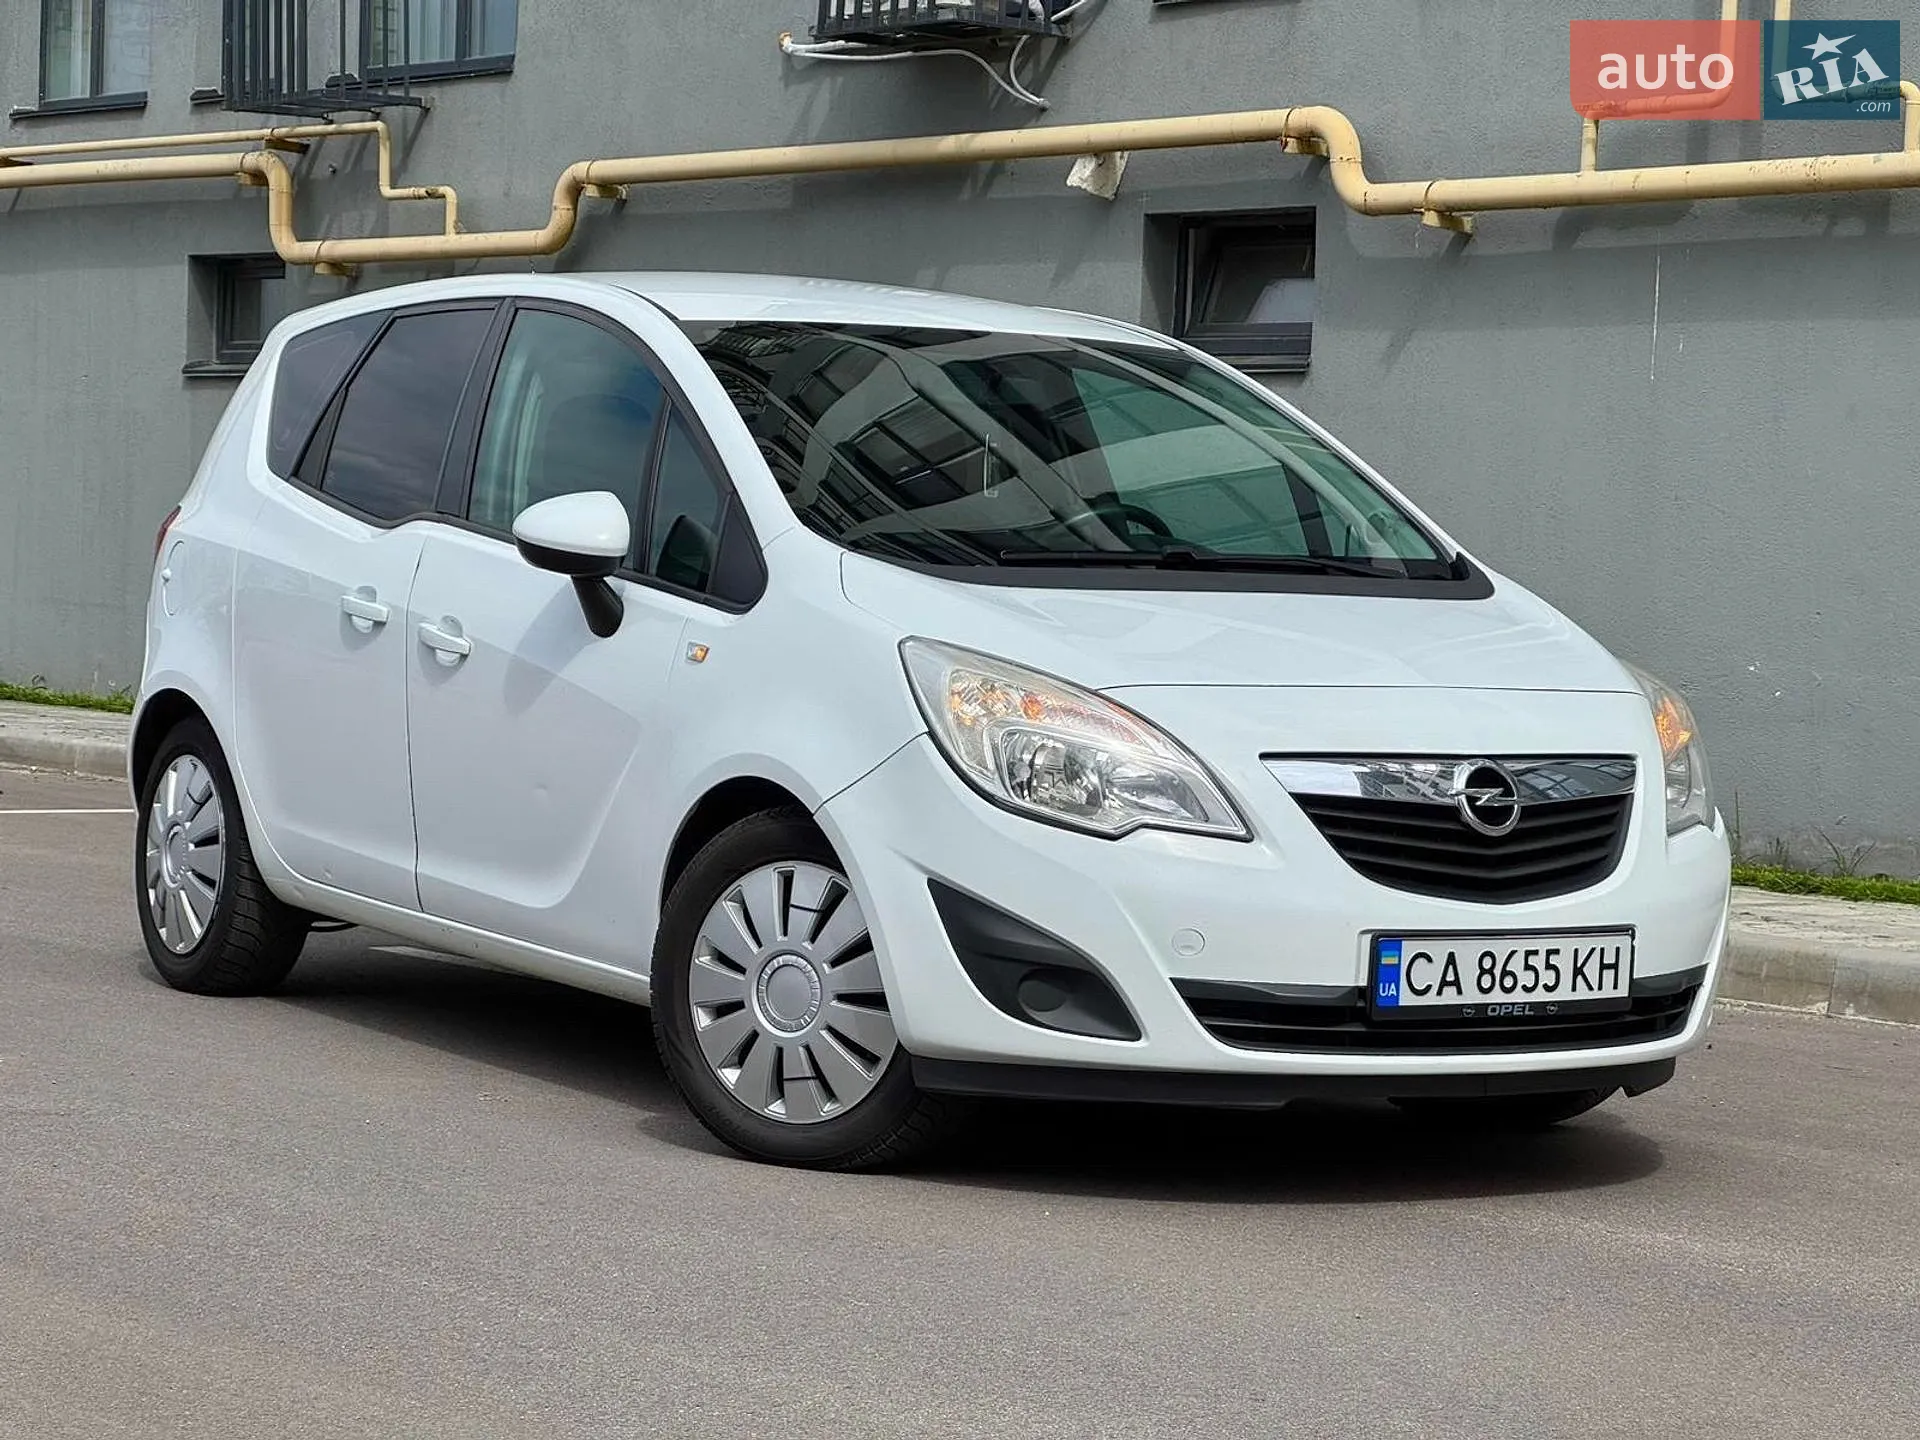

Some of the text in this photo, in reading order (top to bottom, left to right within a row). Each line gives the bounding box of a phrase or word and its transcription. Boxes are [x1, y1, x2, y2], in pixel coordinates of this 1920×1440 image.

[1405, 946, 1620, 996] CA 8655 KH
[1379, 983, 1397, 997] UA
[1487, 1004, 1534, 1016] OPEL
